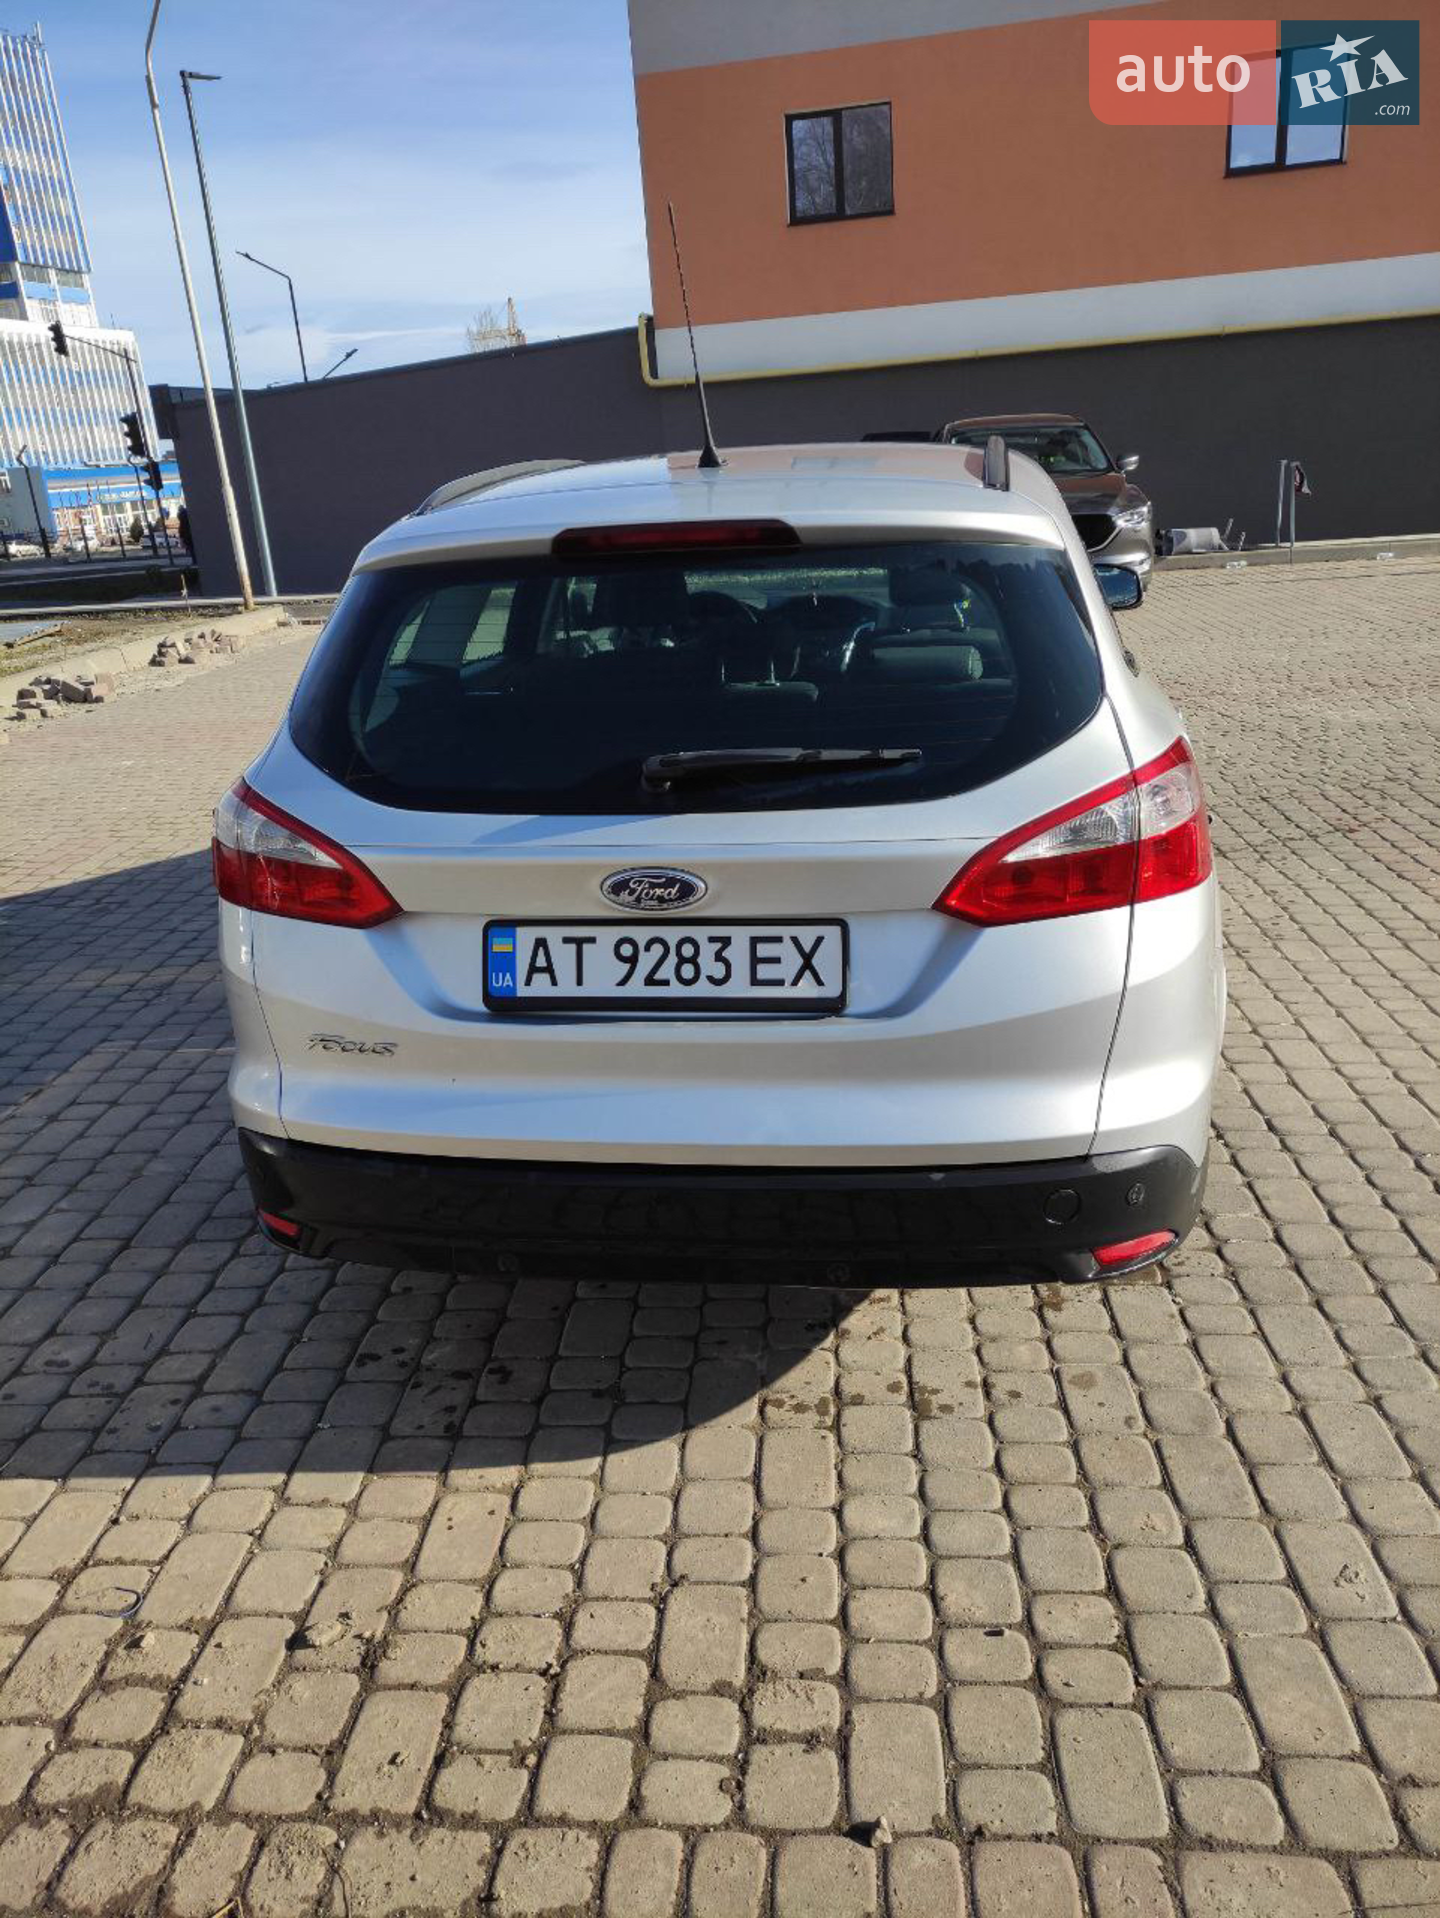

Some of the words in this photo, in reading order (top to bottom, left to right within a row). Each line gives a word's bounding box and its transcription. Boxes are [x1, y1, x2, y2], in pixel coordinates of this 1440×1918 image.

[620, 877, 681, 901] Ford
[524, 936, 597, 987] AT
[613, 936, 732, 987] 9283
[749, 936, 826, 987] EX
[492, 972, 513, 987] UA
[308, 1033, 398, 1056] Focus
